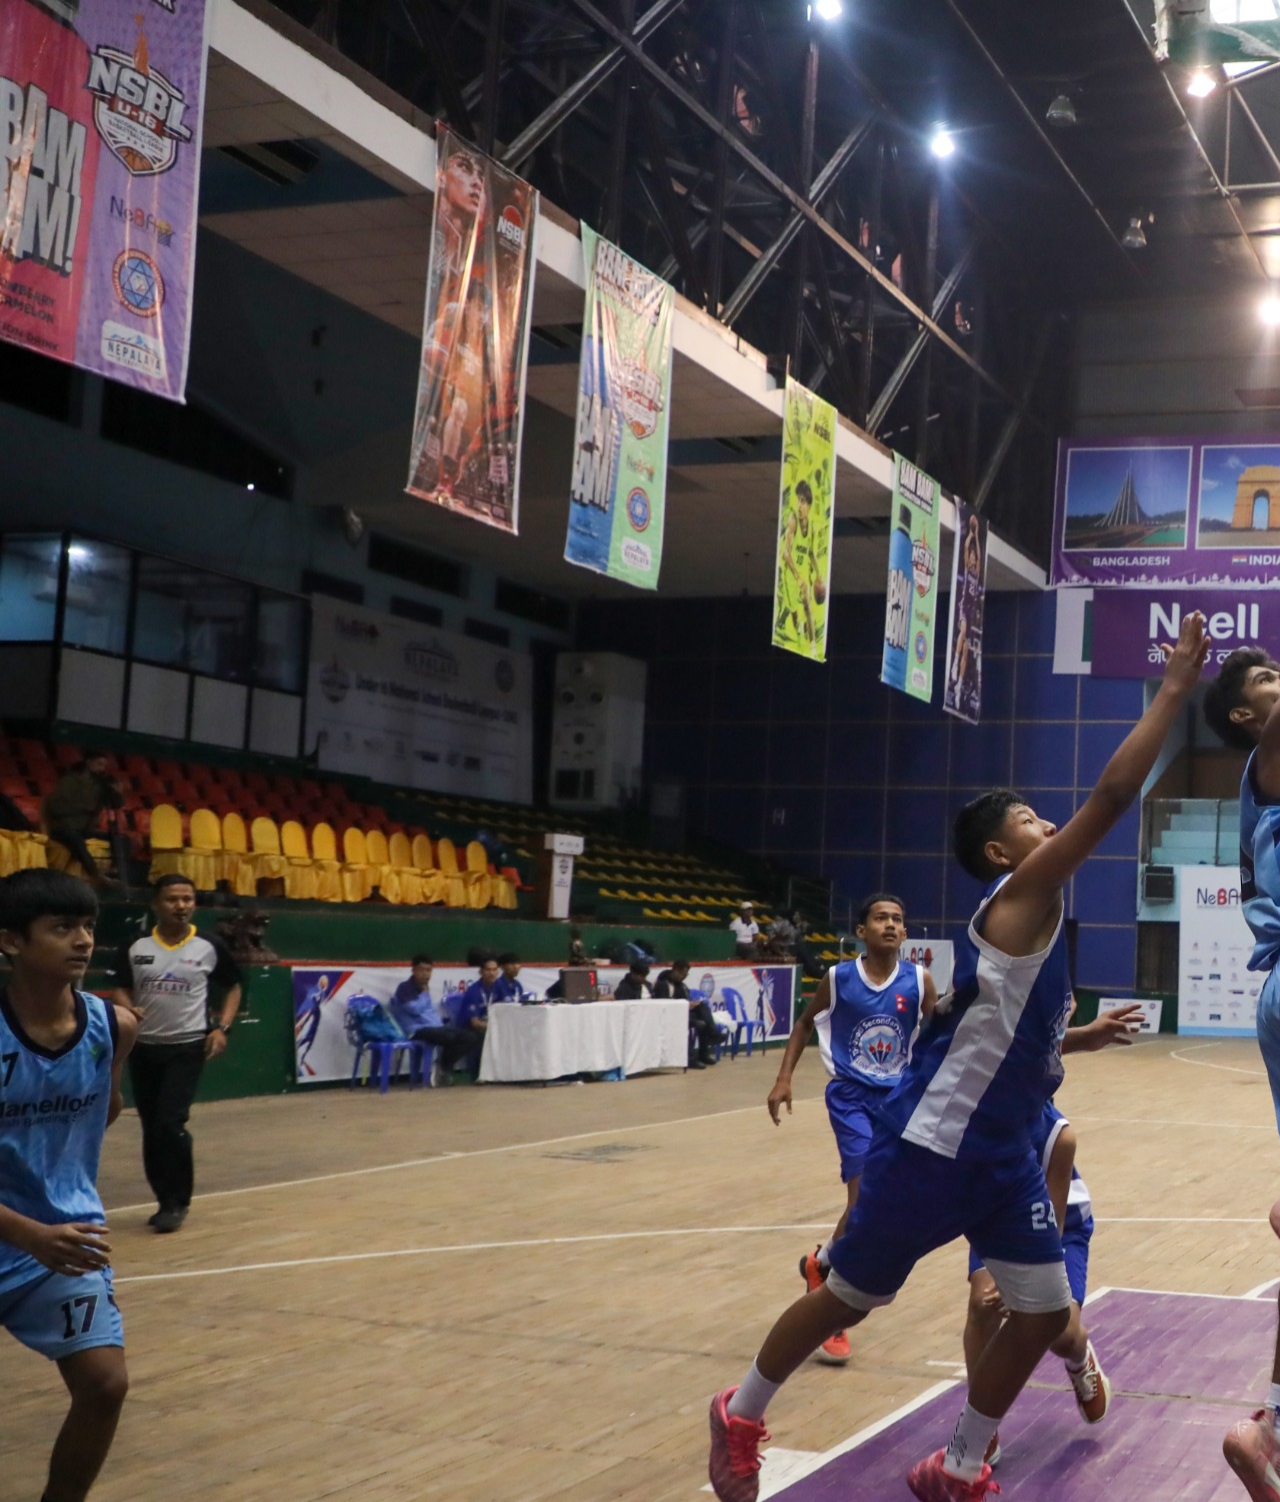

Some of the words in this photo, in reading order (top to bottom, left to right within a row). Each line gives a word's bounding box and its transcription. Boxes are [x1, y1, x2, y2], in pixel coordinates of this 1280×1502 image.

[88, 51, 192, 143] NSBL
[117, 100, 157, 130] U-16
[0, 76, 87, 198] BAM
[496, 215, 527, 250] NSBL
[108, 340, 161, 371] NEPALAYA
[1092, 555, 1170, 567] BANGLADESH
[862, 1017, 900, 1031] Secondary
[1031, 1200, 1058, 1231] 24
[61, 1294, 99, 1341] 17
